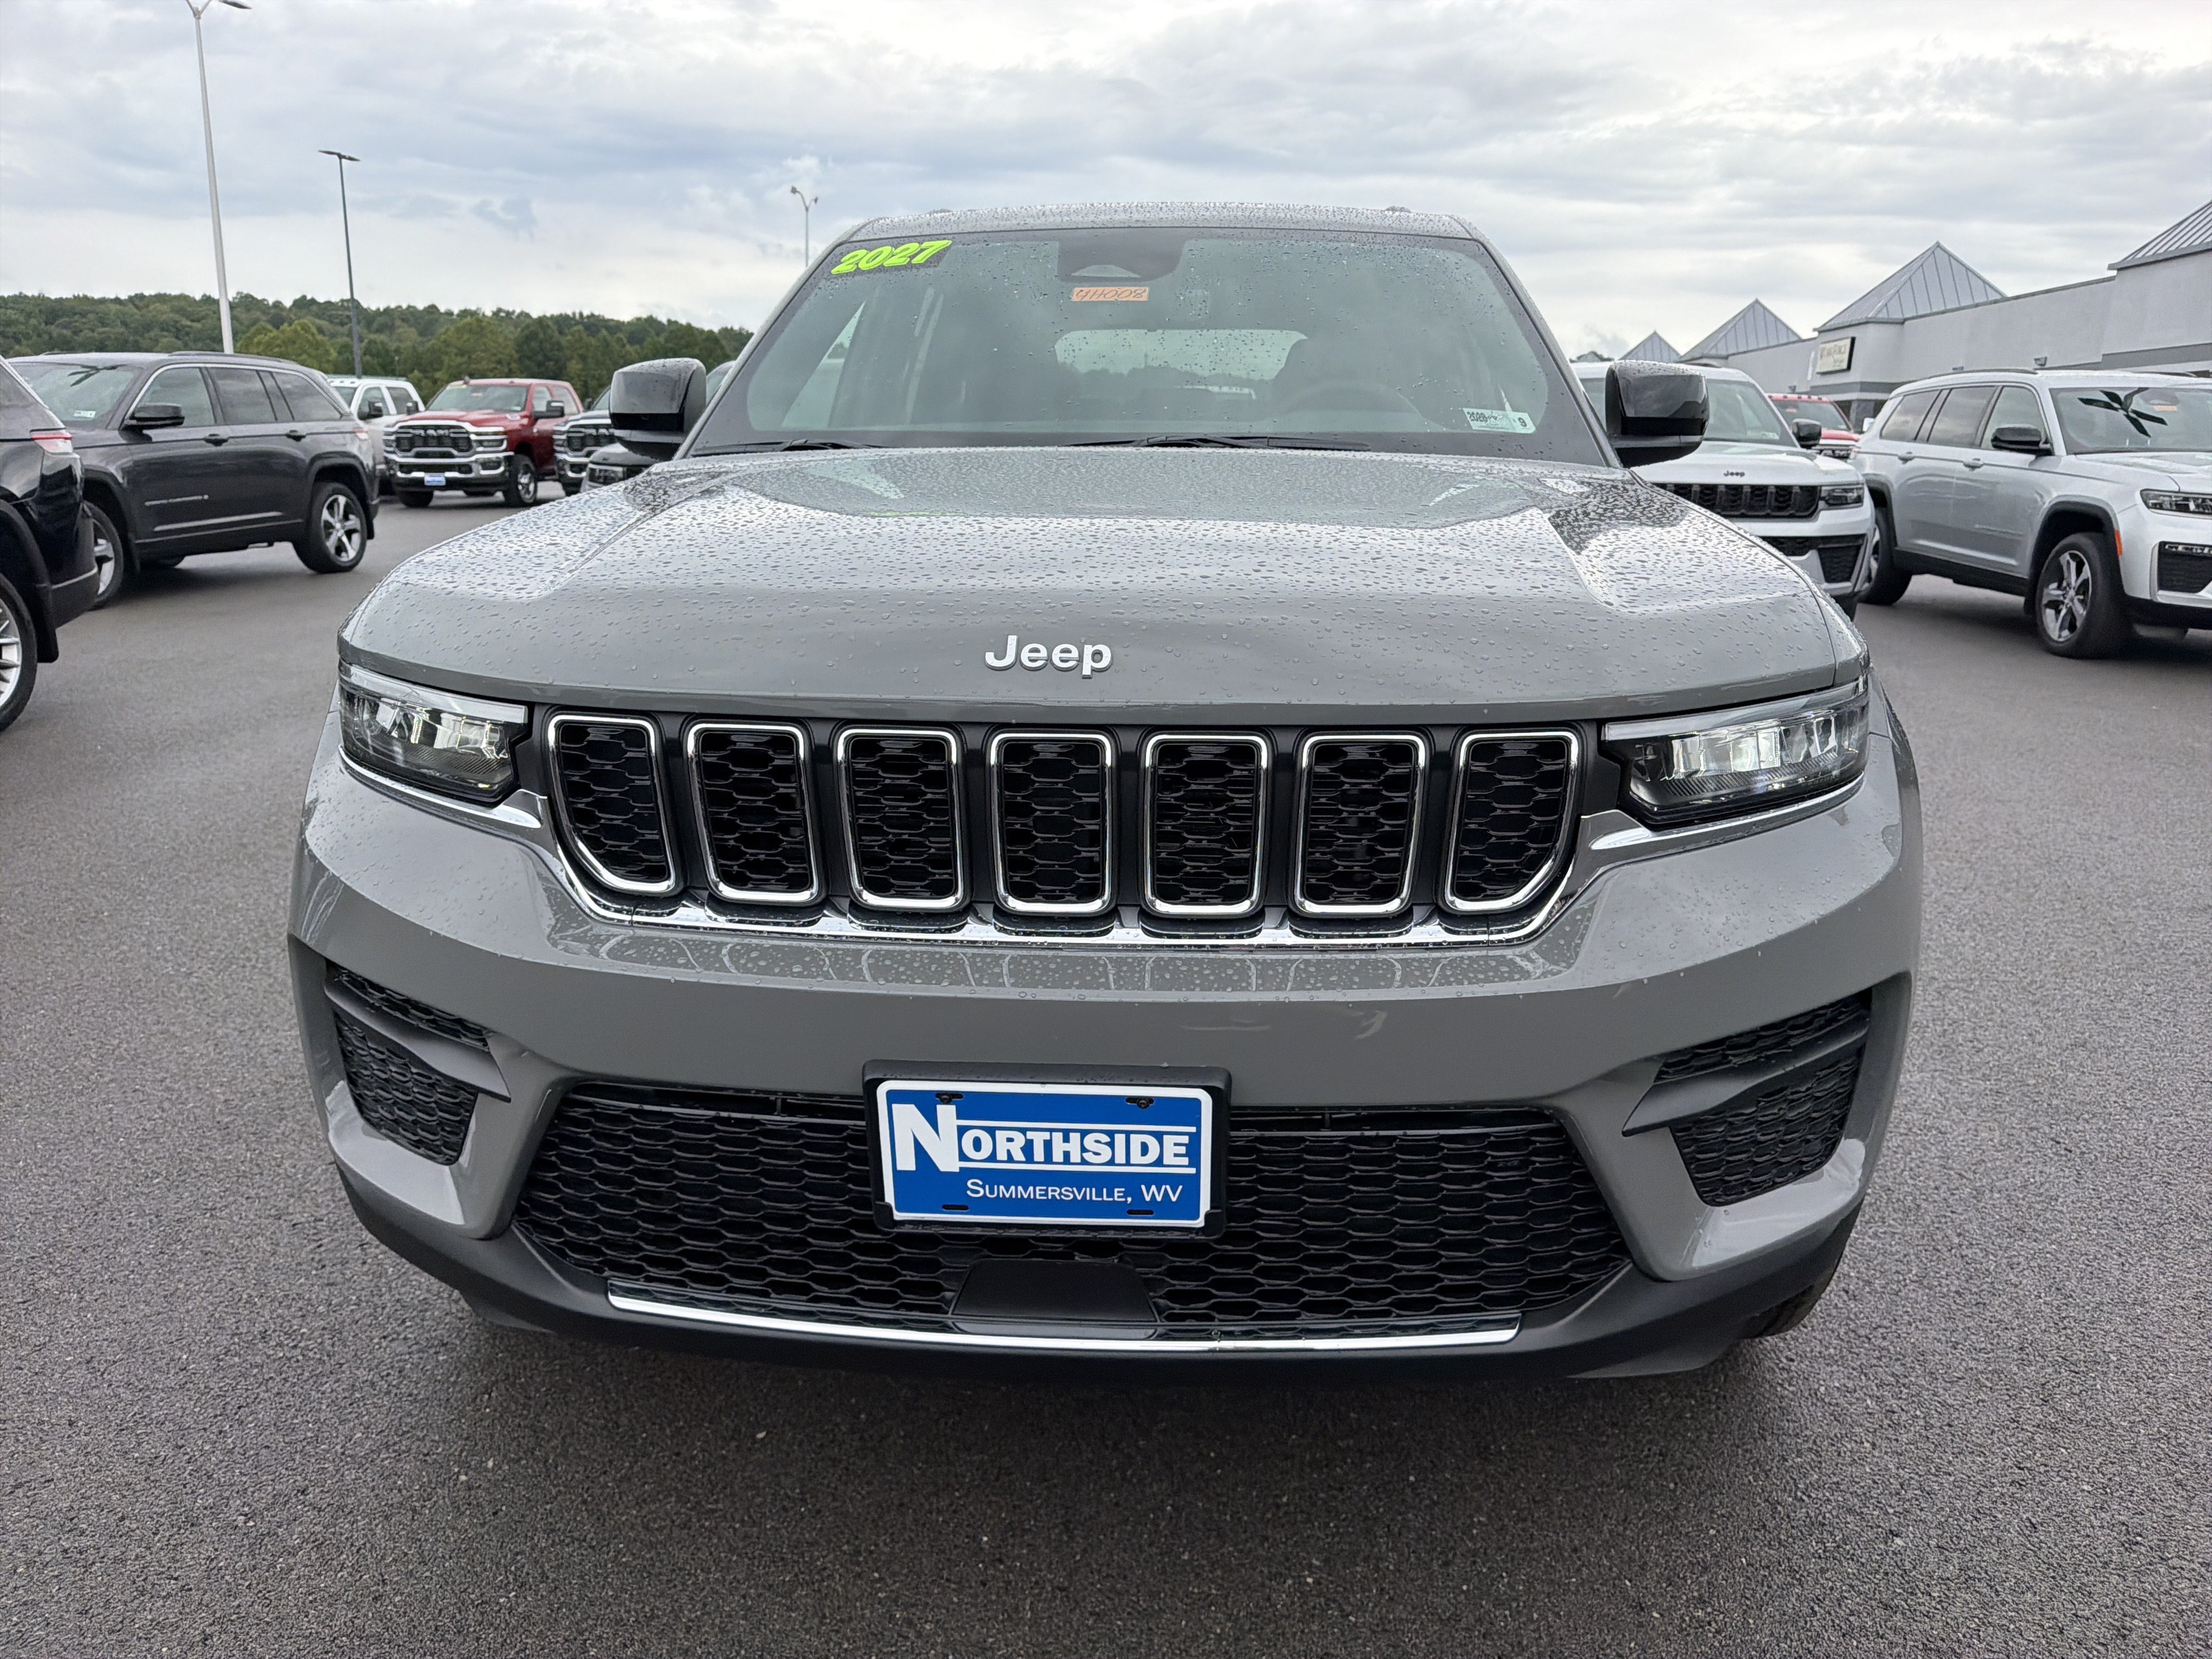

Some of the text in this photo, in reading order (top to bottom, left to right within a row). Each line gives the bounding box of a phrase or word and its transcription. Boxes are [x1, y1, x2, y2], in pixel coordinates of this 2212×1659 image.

[831, 240, 952, 274] 2027
[1517, 417, 1527, 427] 9
[985, 635, 1113, 679] Jeep
[891, 1103, 1189, 1172] NORTHSIDE
[1141, 1184, 1183, 1201] WV
